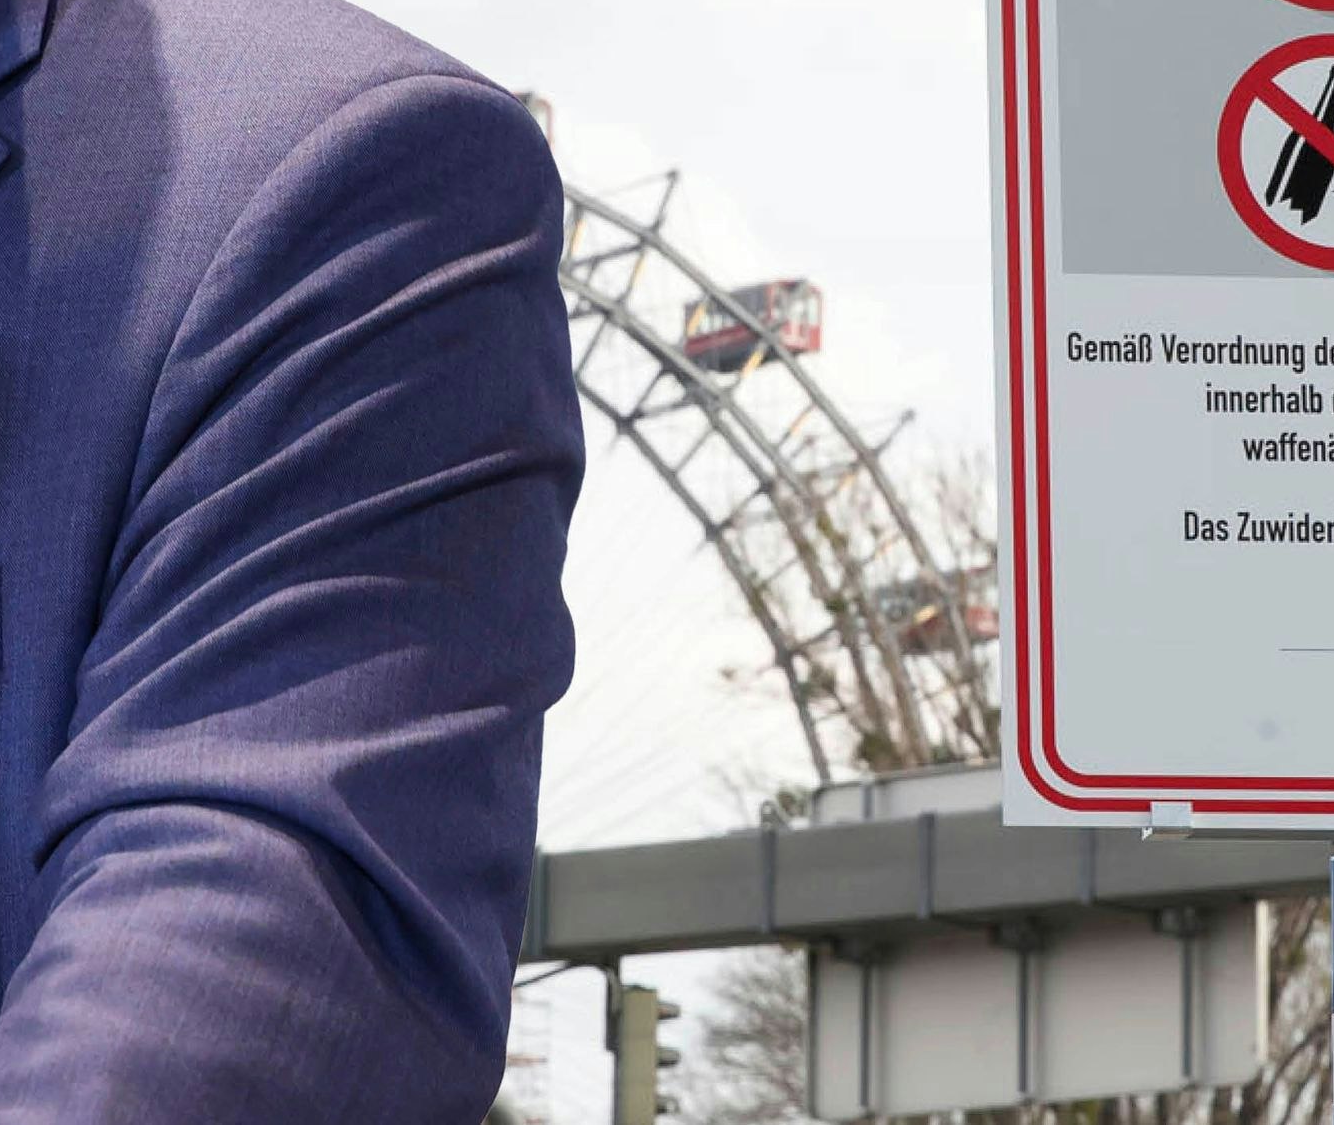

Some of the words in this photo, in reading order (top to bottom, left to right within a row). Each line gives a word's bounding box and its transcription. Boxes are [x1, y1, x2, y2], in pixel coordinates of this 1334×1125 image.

[1067, 331, 1153, 363] Gemäß
[1160, 333, 1306, 375] Verordnung
[1206, 381, 1324, 414] innerhalb
[1184, 510, 1229, 542] Das
